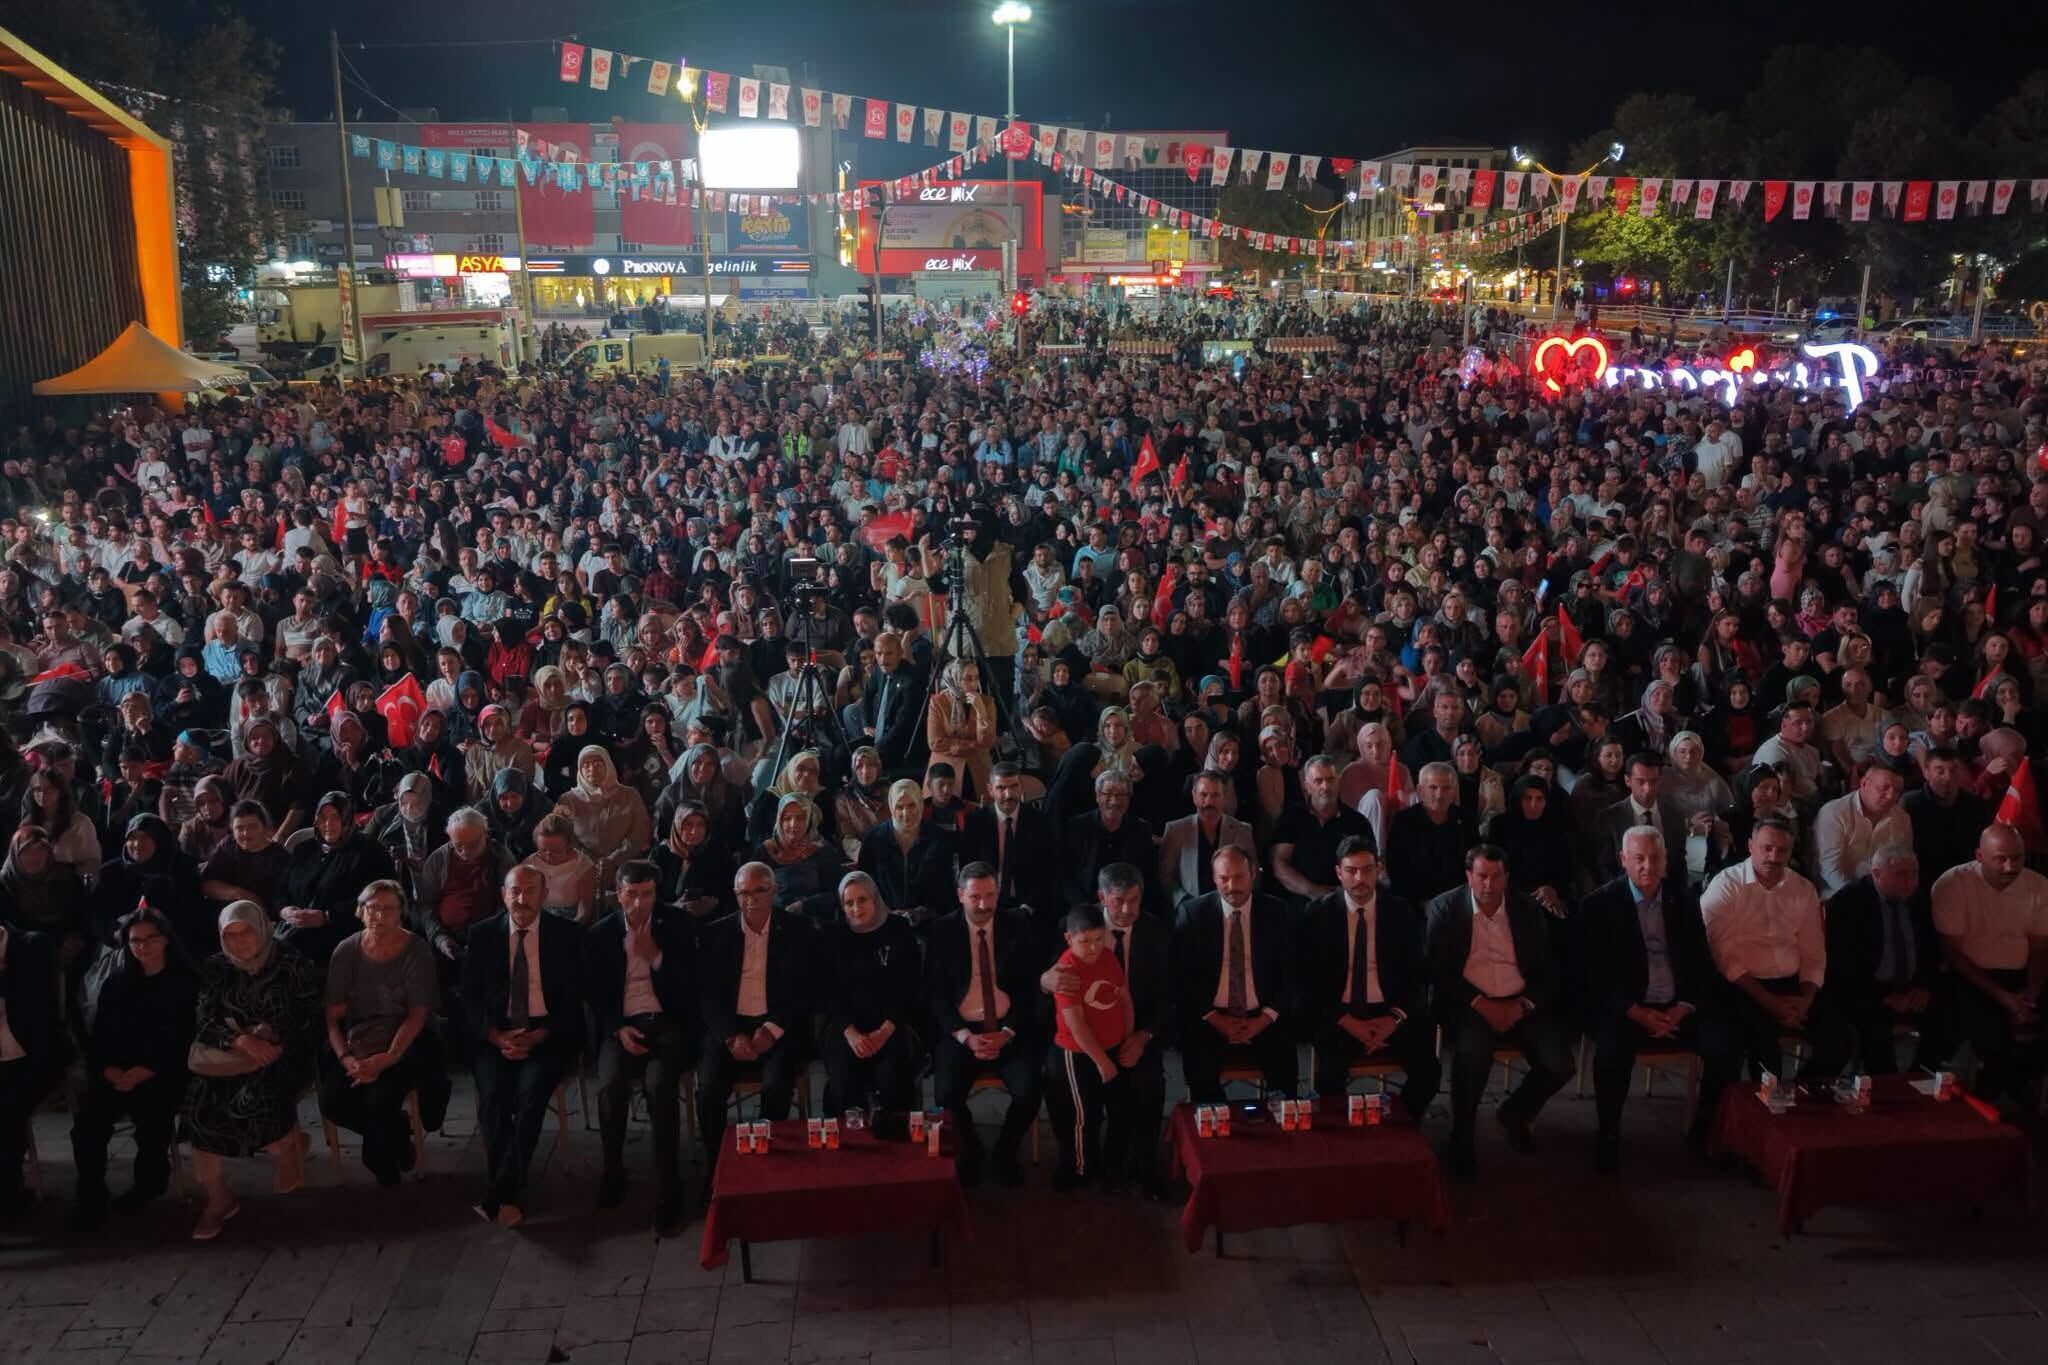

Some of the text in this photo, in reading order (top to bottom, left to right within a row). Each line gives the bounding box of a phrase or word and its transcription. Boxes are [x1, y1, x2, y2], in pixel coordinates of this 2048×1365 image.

[920, 182, 980, 203] ece mix
[460, 256, 505, 272] ASYA
[623, 260, 687, 274] PRONOVA
[925, 254, 977, 271] ece mix
